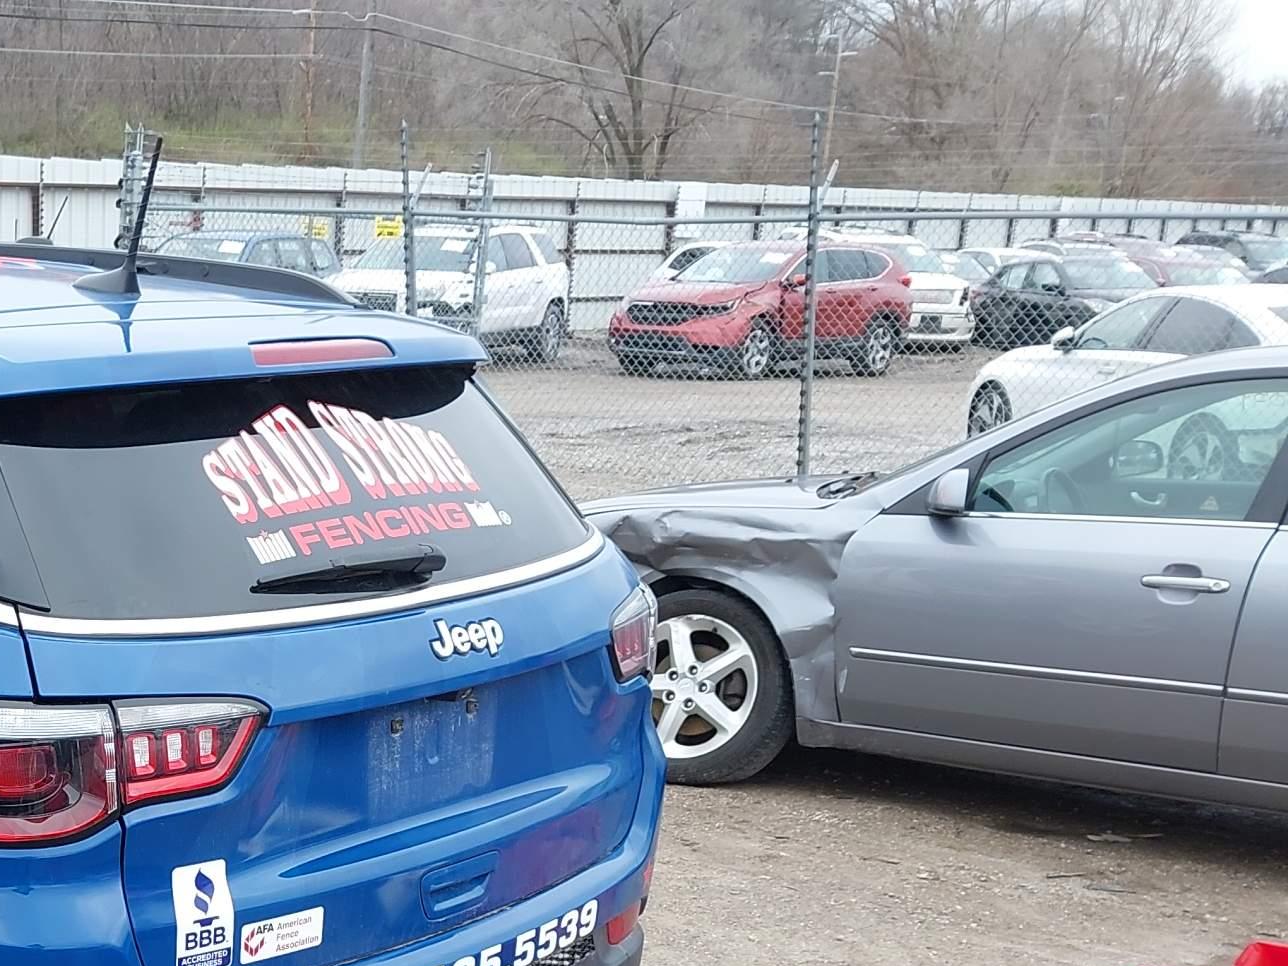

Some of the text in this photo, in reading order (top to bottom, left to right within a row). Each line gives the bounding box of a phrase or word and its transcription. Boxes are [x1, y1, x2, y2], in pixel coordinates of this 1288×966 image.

[202, 399, 481, 524] STAND STRONG
[289, 502, 472, 556] FENCING
[429, 616, 505, 662] Jeep
[256, 916, 312, 935] AFA American
[276, 930, 299, 941] Fence
[185, 926, 226, 951] BBB
[275, 935, 319, 952] Association
[181, 950, 229, 966] ACCREDITED
